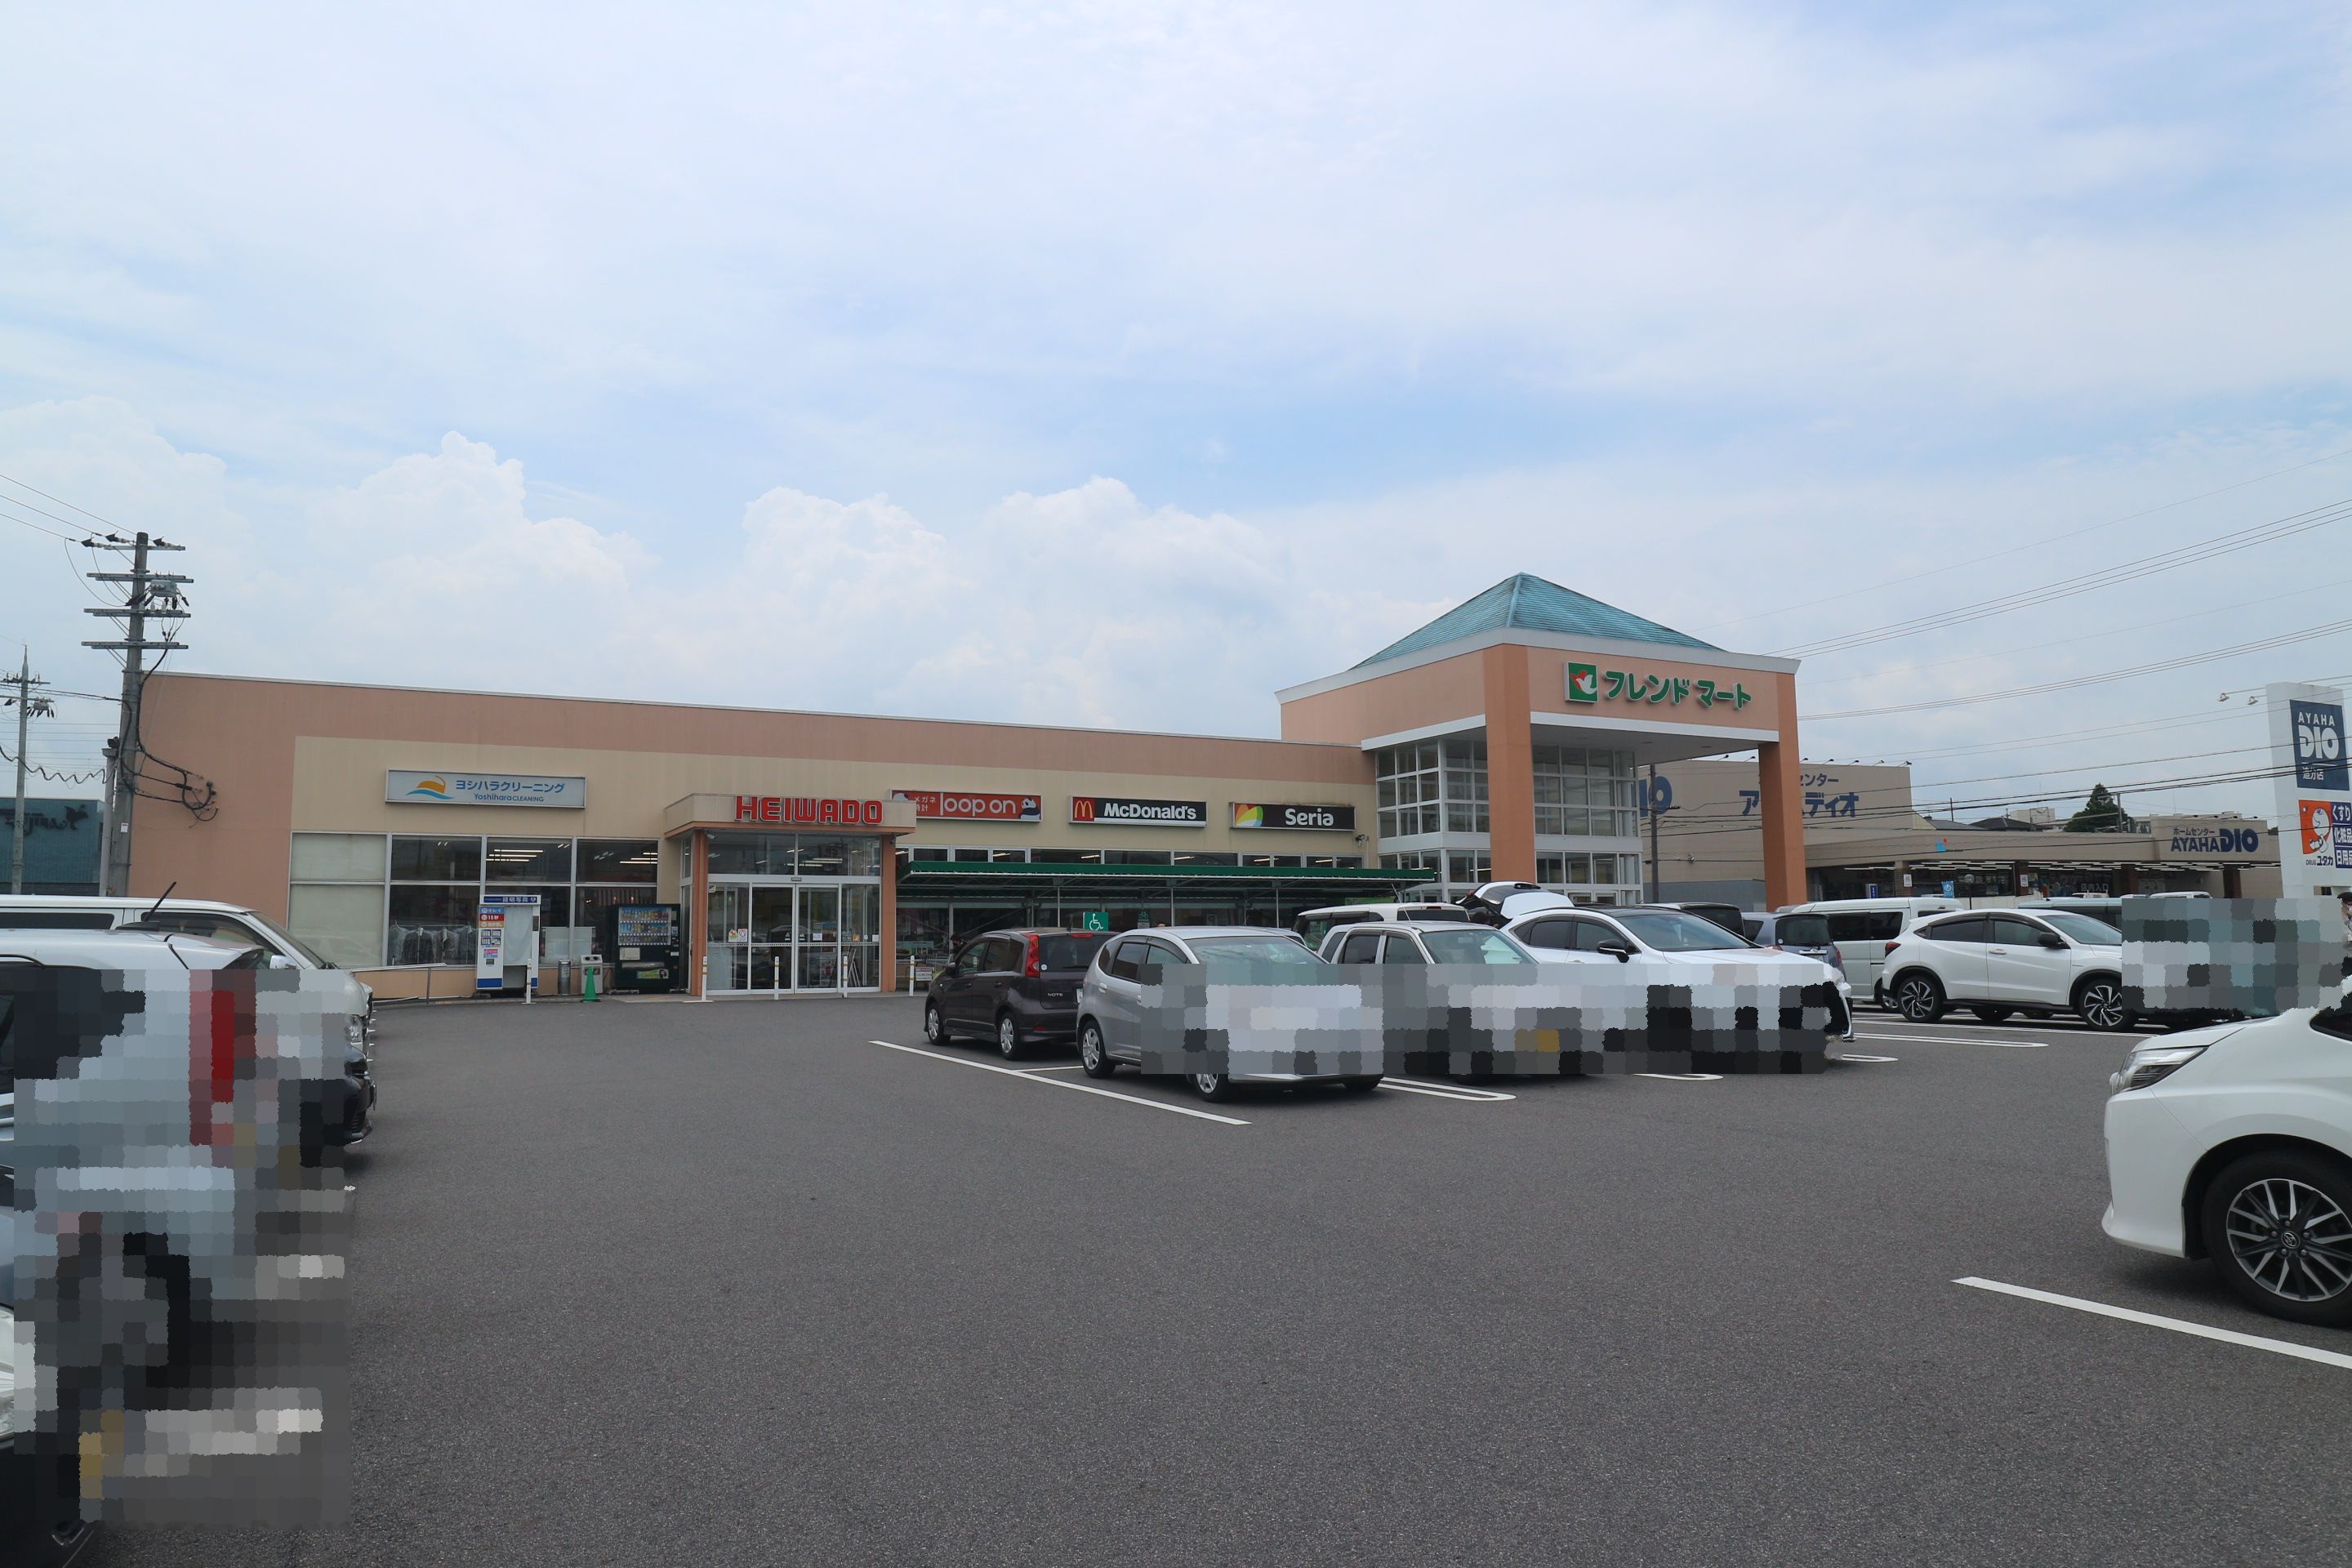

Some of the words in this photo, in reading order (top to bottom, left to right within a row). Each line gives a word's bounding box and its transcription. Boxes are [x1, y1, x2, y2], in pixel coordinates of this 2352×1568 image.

[2297, 711, 2336, 726] AYAHA
[2297, 724, 2340, 760] DIO
[456, 779, 566, 794] ヨシハラクリーニング
[474, 793, 513, 801] Yoshihara
[736, 795, 884, 825] HEIWADO
[989, 798, 1017, 814] on
[1103, 802, 1197, 820] McDonald's
[2332, 804, 2351, 822] くすり
[1285, 808, 1334, 826] Seria
[2172, 826, 2216, 836] ホームセンター
[2171, 836, 2220, 853] AYAHA
[2219, 828, 2259, 853] DIO
[2317, 855, 2334, 866] ユタカ
